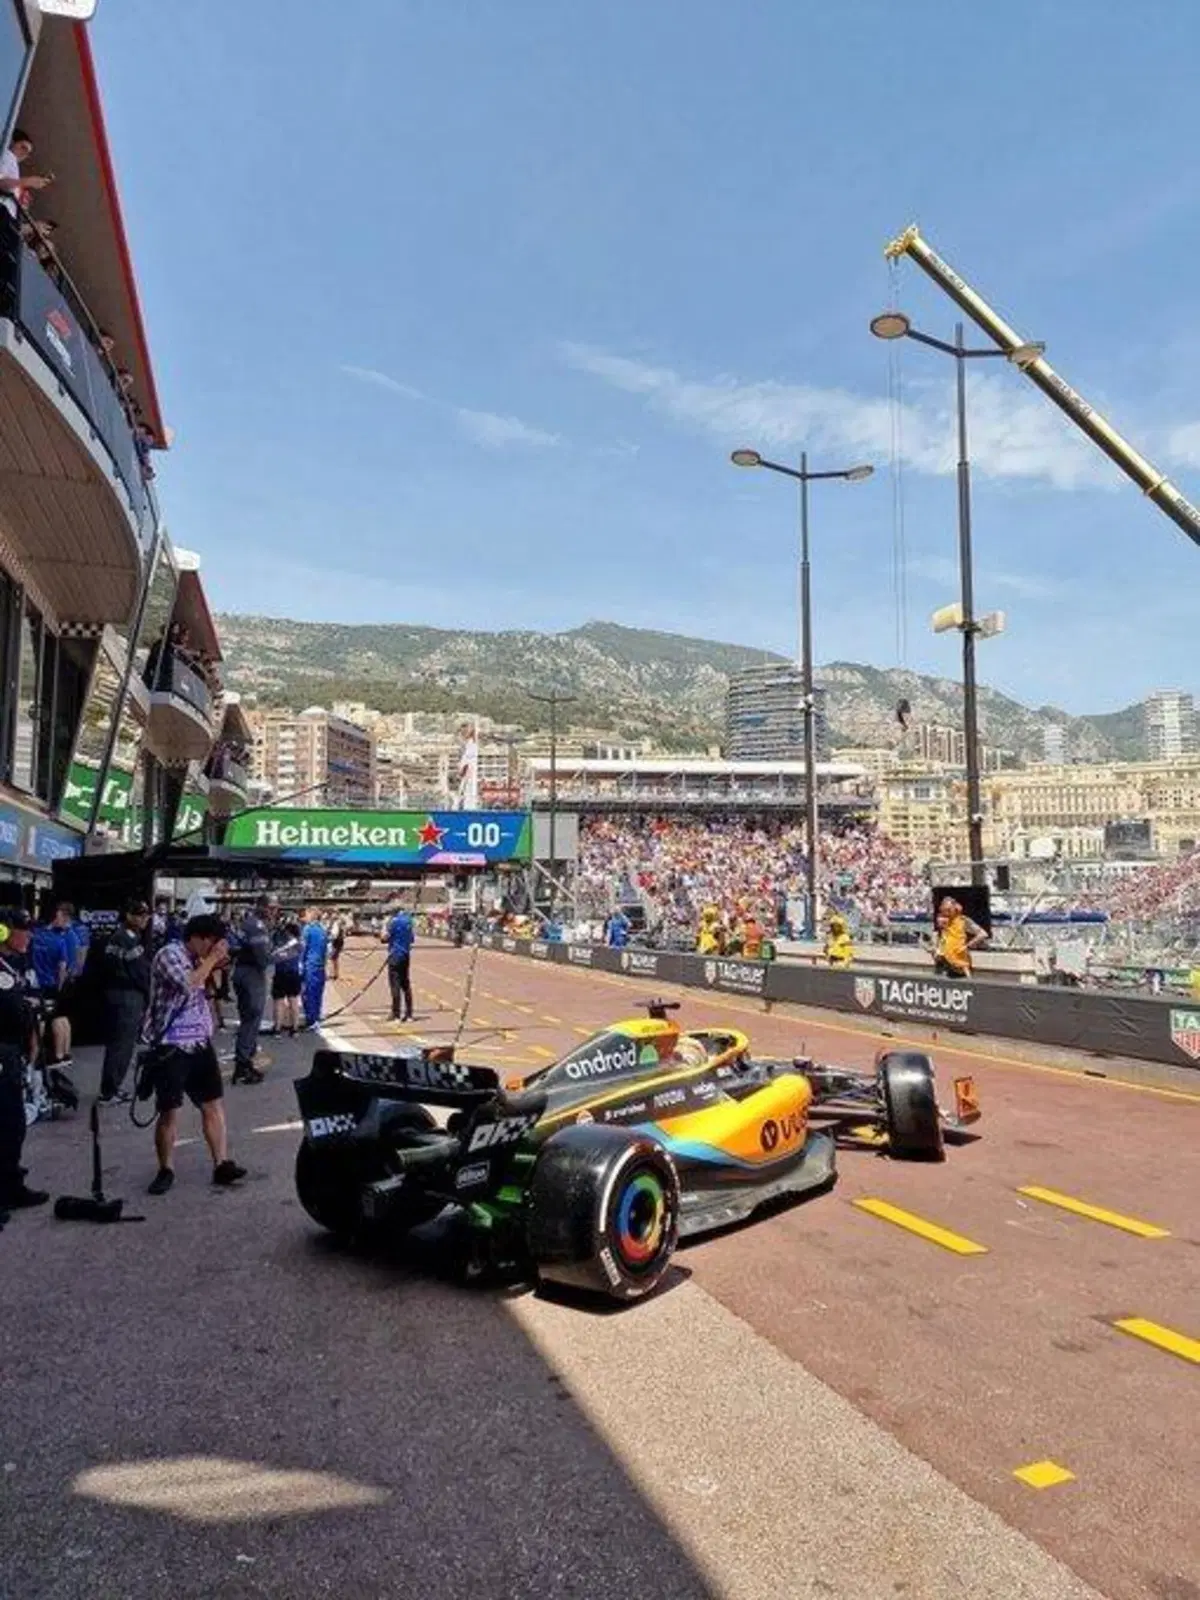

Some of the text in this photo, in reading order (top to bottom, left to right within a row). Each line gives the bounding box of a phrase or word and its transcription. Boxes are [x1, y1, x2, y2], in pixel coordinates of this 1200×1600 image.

[255, 819, 406, 847] Heineken
[1175, 1012, 1199, 1029] TA
[407, 1060, 474, 1089] OKX
[565, 1042, 637, 1080] android
[309, 1112, 357, 1137] OKX
[468, 1112, 538, 1153] OKX
